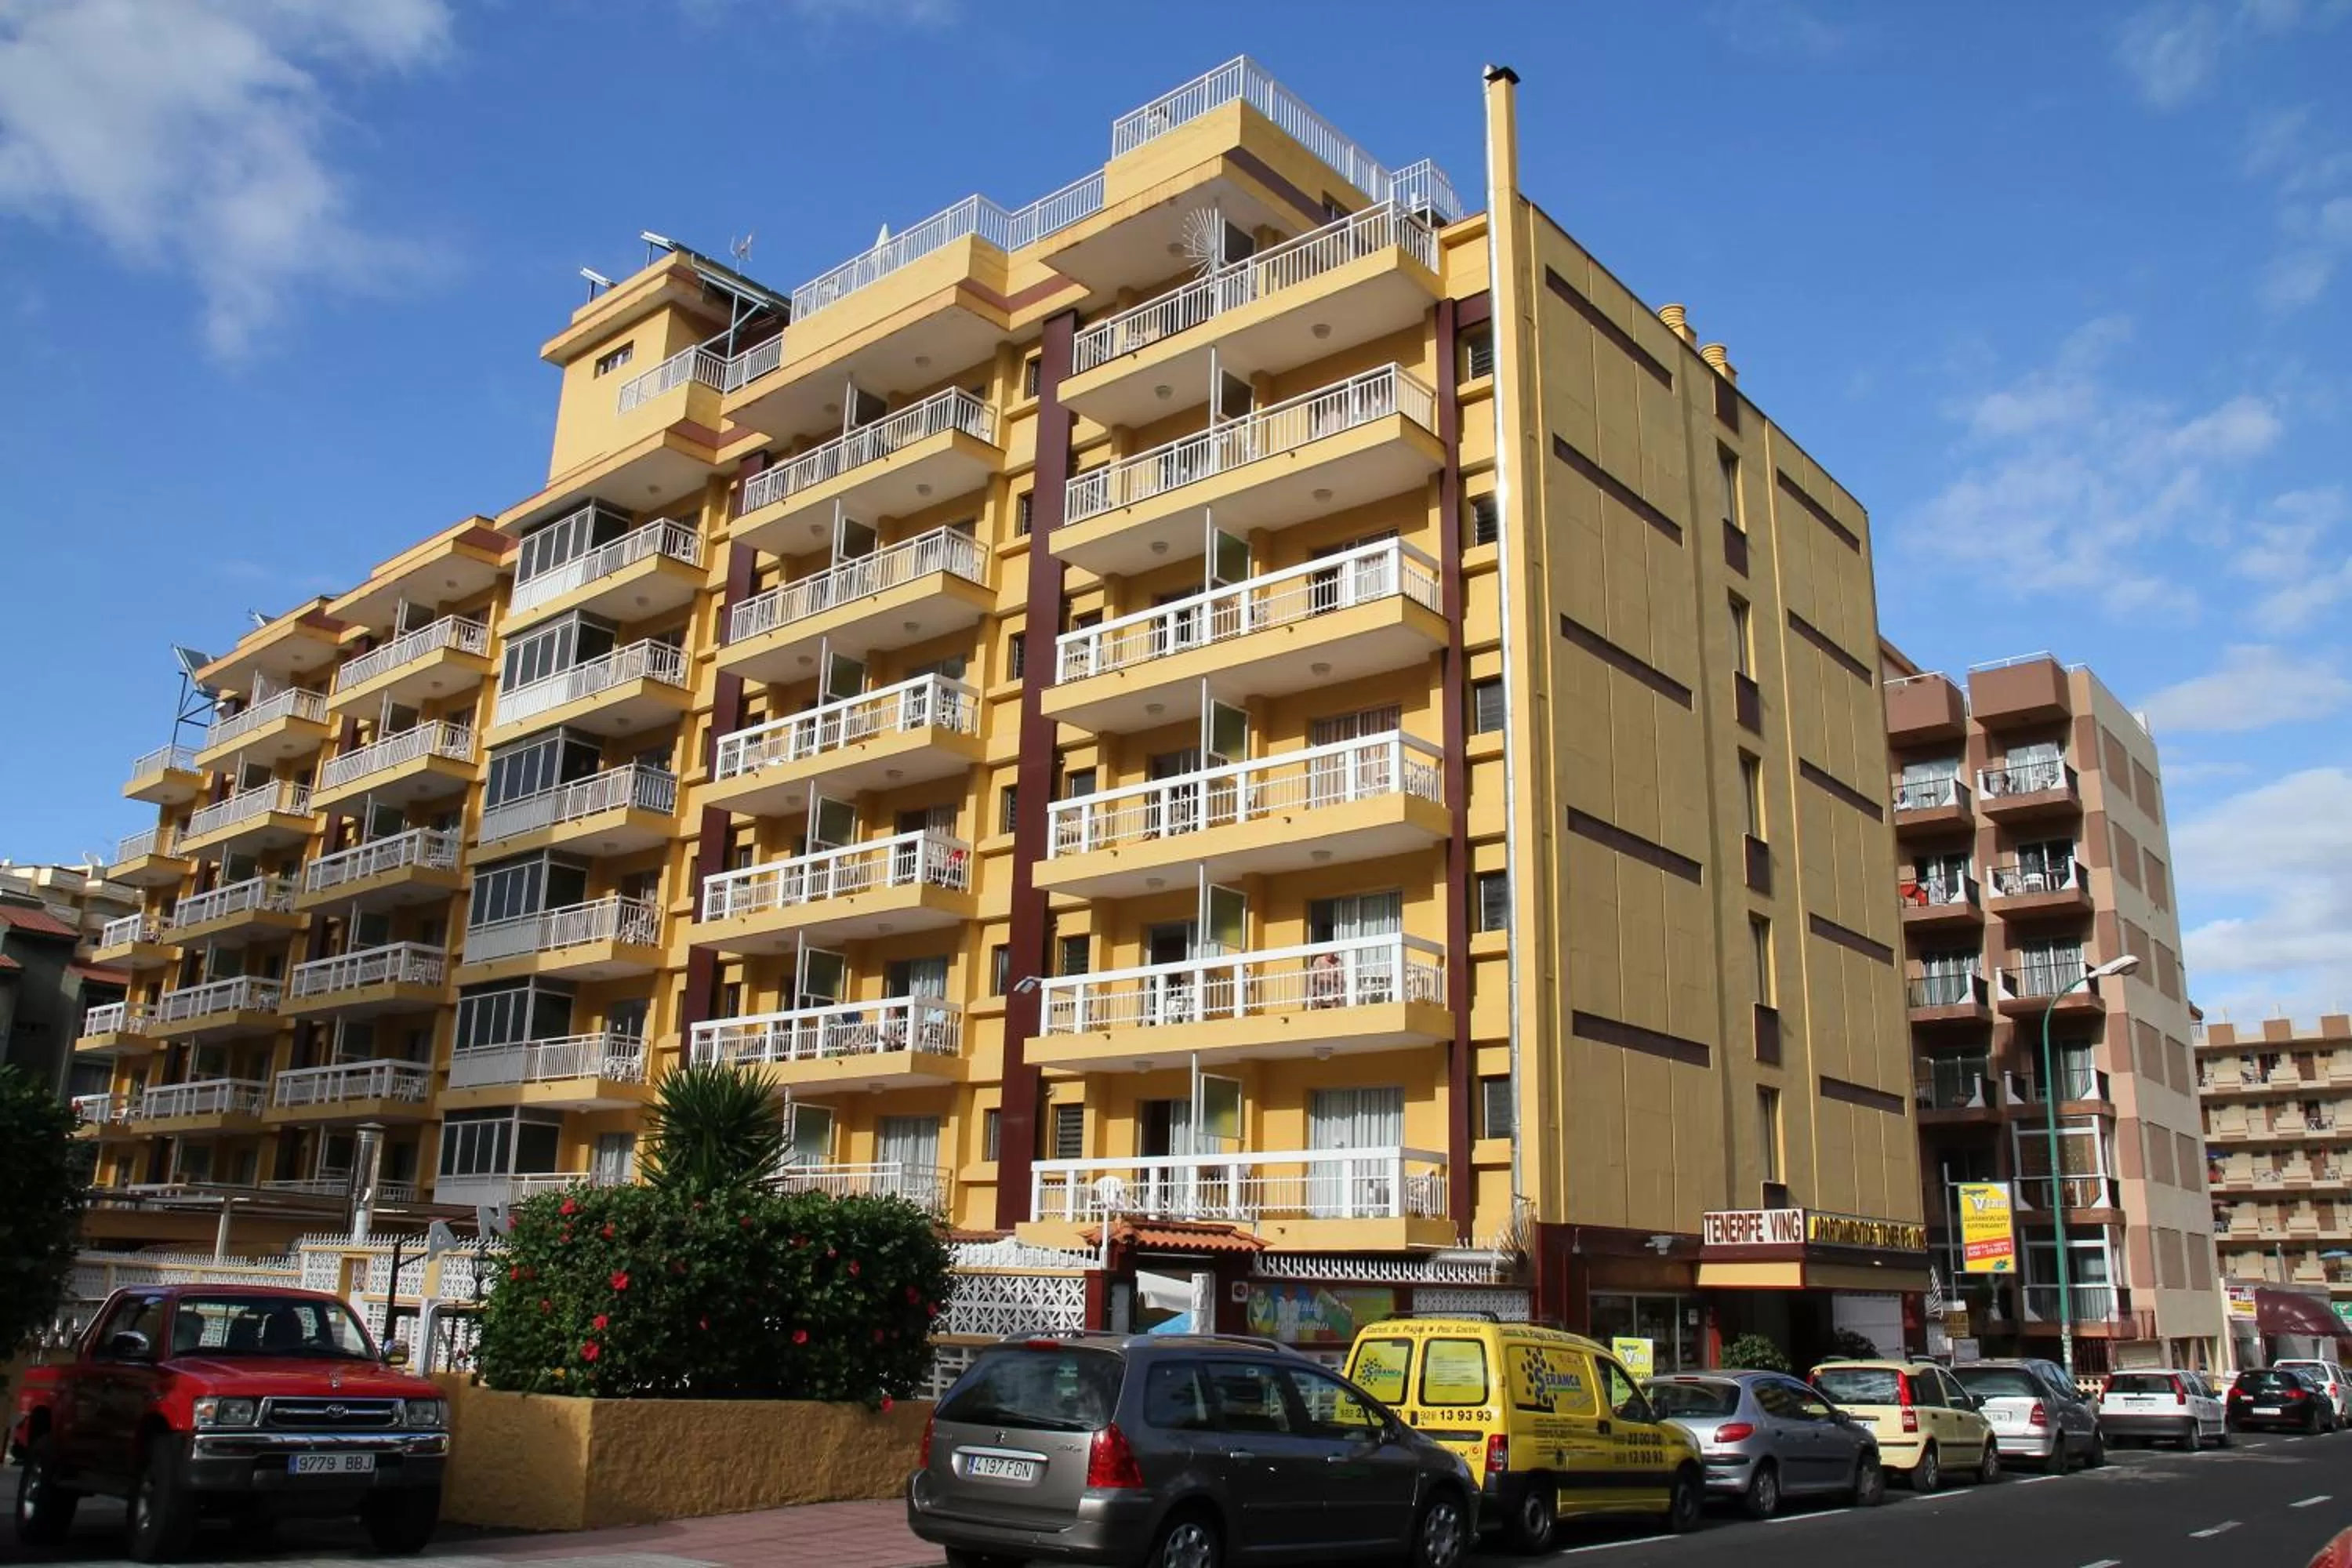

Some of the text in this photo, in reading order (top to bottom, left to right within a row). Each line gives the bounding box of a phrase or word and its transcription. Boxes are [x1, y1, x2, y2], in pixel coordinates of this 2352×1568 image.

[1704, 1210, 1801, 1243] TENERIFE VING
[1440, 1410, 1454, 1421] 13
[1457, 1411, 1472, 1421] 93
[1476, 1411, 1492, 1421] 93
[299, 1456, 372, 1471] 9779 BBJ
[975, 1457, 1032, 1479] 4197 FDN
